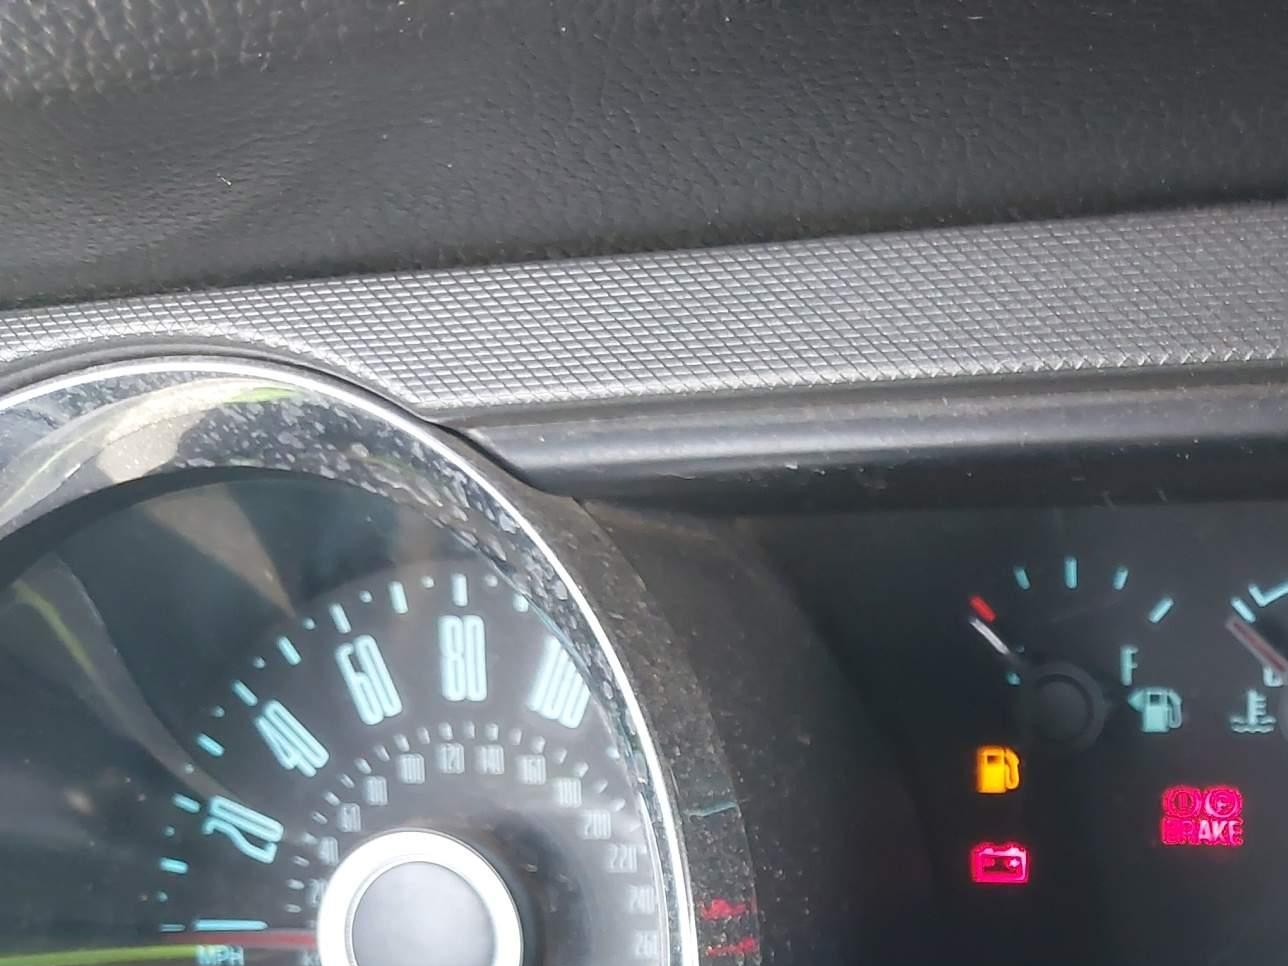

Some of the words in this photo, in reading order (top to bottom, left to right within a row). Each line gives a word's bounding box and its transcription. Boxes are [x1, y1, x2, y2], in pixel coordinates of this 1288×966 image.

[335, 634, 403, 726] 60
[439, 615, 486, 702] 80
[1120, 645, 1138, 686] F
[255, 700, 330, 777] 40
[203, 796, 284, 864] 20
